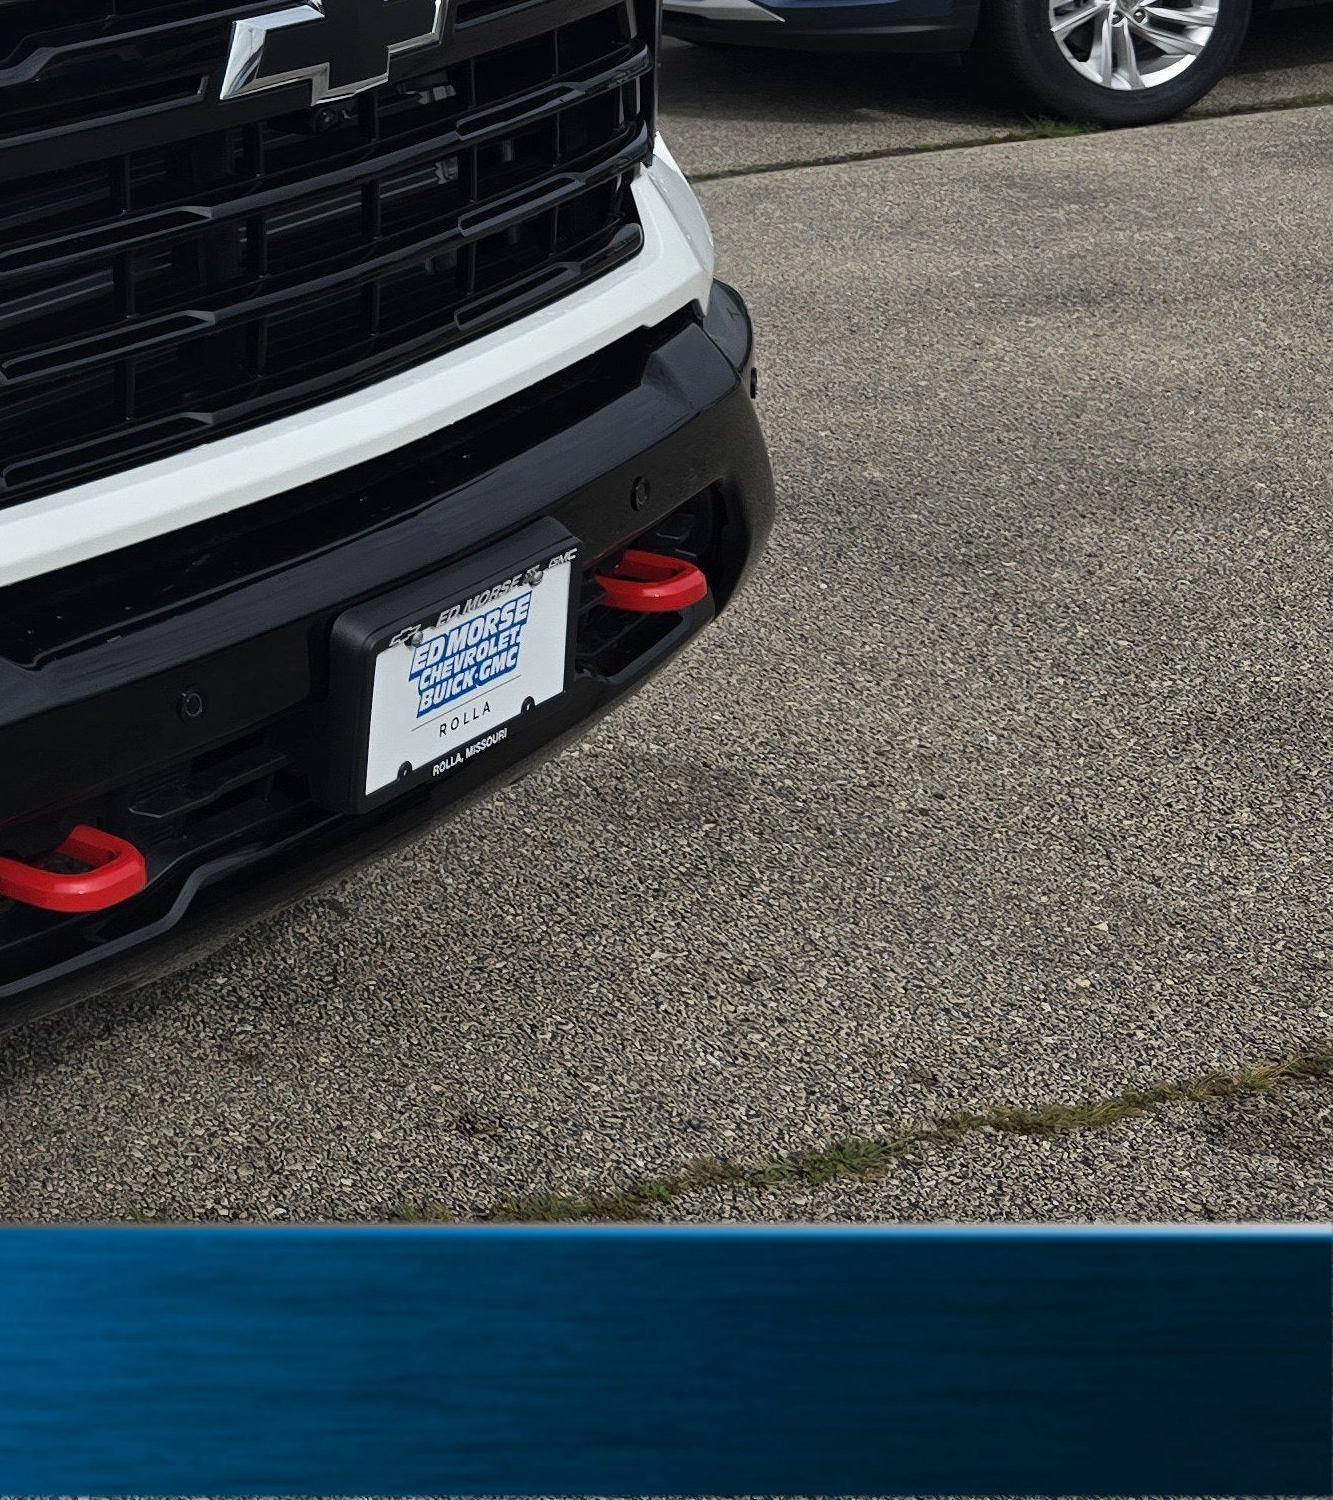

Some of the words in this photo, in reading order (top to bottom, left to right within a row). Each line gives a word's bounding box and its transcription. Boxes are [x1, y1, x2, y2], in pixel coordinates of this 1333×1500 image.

[548, 547, 578, 569] GMC
[435, 604, 461, 628] ED
[463, 573, 523, 616] MORSE
[410, 634, 445, 675] ED
[445, 593, 531, 658] MORSE
[419, 624, 521, 691] CHEVROLET
[439, 700, 491, 738] ROLLA
[432, 752, 464, 777] ROLLA,
[465, 727, 508, 759] MISSOURI
